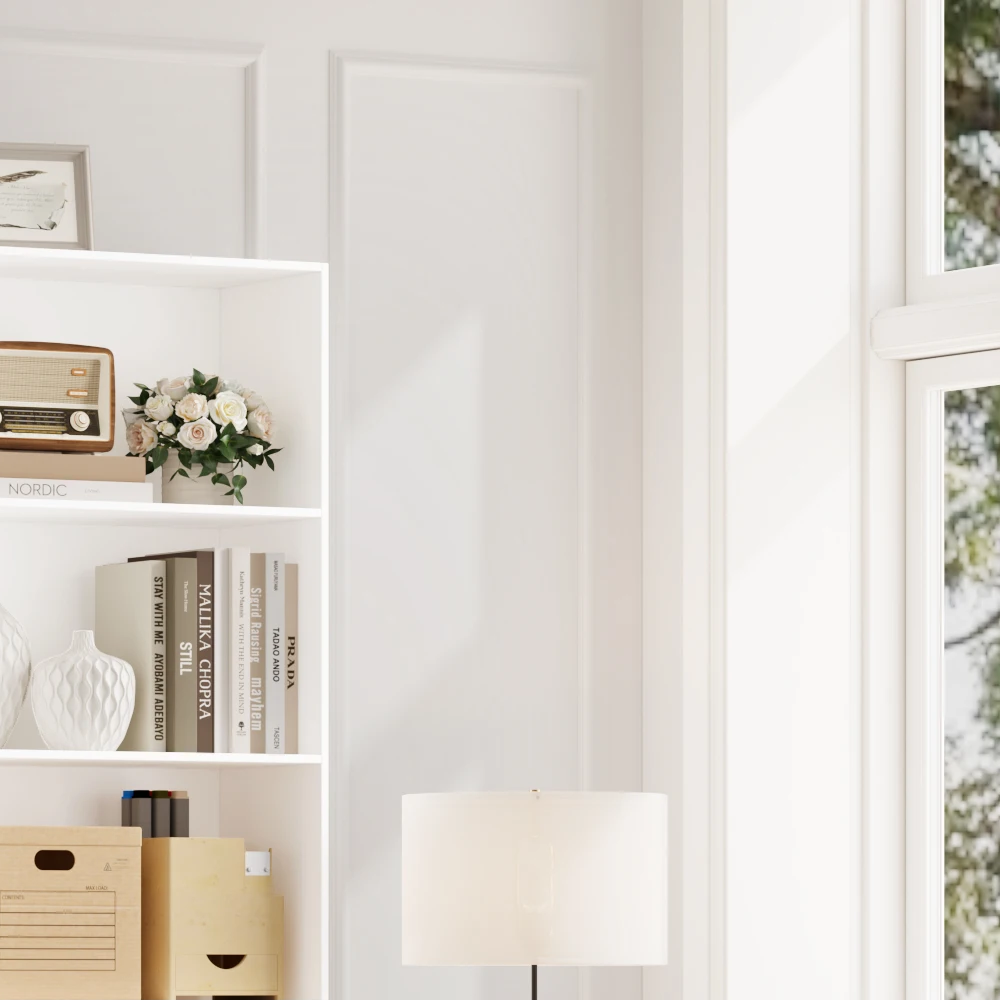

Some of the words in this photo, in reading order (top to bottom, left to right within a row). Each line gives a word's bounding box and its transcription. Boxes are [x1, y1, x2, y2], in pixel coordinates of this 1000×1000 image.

[8, 483, 67, 496] NORDIC
[154, 576, 163, 600] STAY
[251, 588, 262, 618] Sigrid
[154, 603, 164, 628] WITH
[199, 584, 212, 651] MALLIKA
[154, 630, 164, 645] ME
[250, 622, 262, 663] Rausing
[272, 627, 280, 656] TADAO
[154, 652, 164, 695] AYOBAMI
[180, 642, 192, 676] STILL
[272, 658, 280, 682] ANDO
[286, 636, 296, 690] PRADA
[199, 658, 212, 720] CHOPRA
[251, 678, 264, 731] mayhem
[154, 698, 164, 741] ADEBAYO
